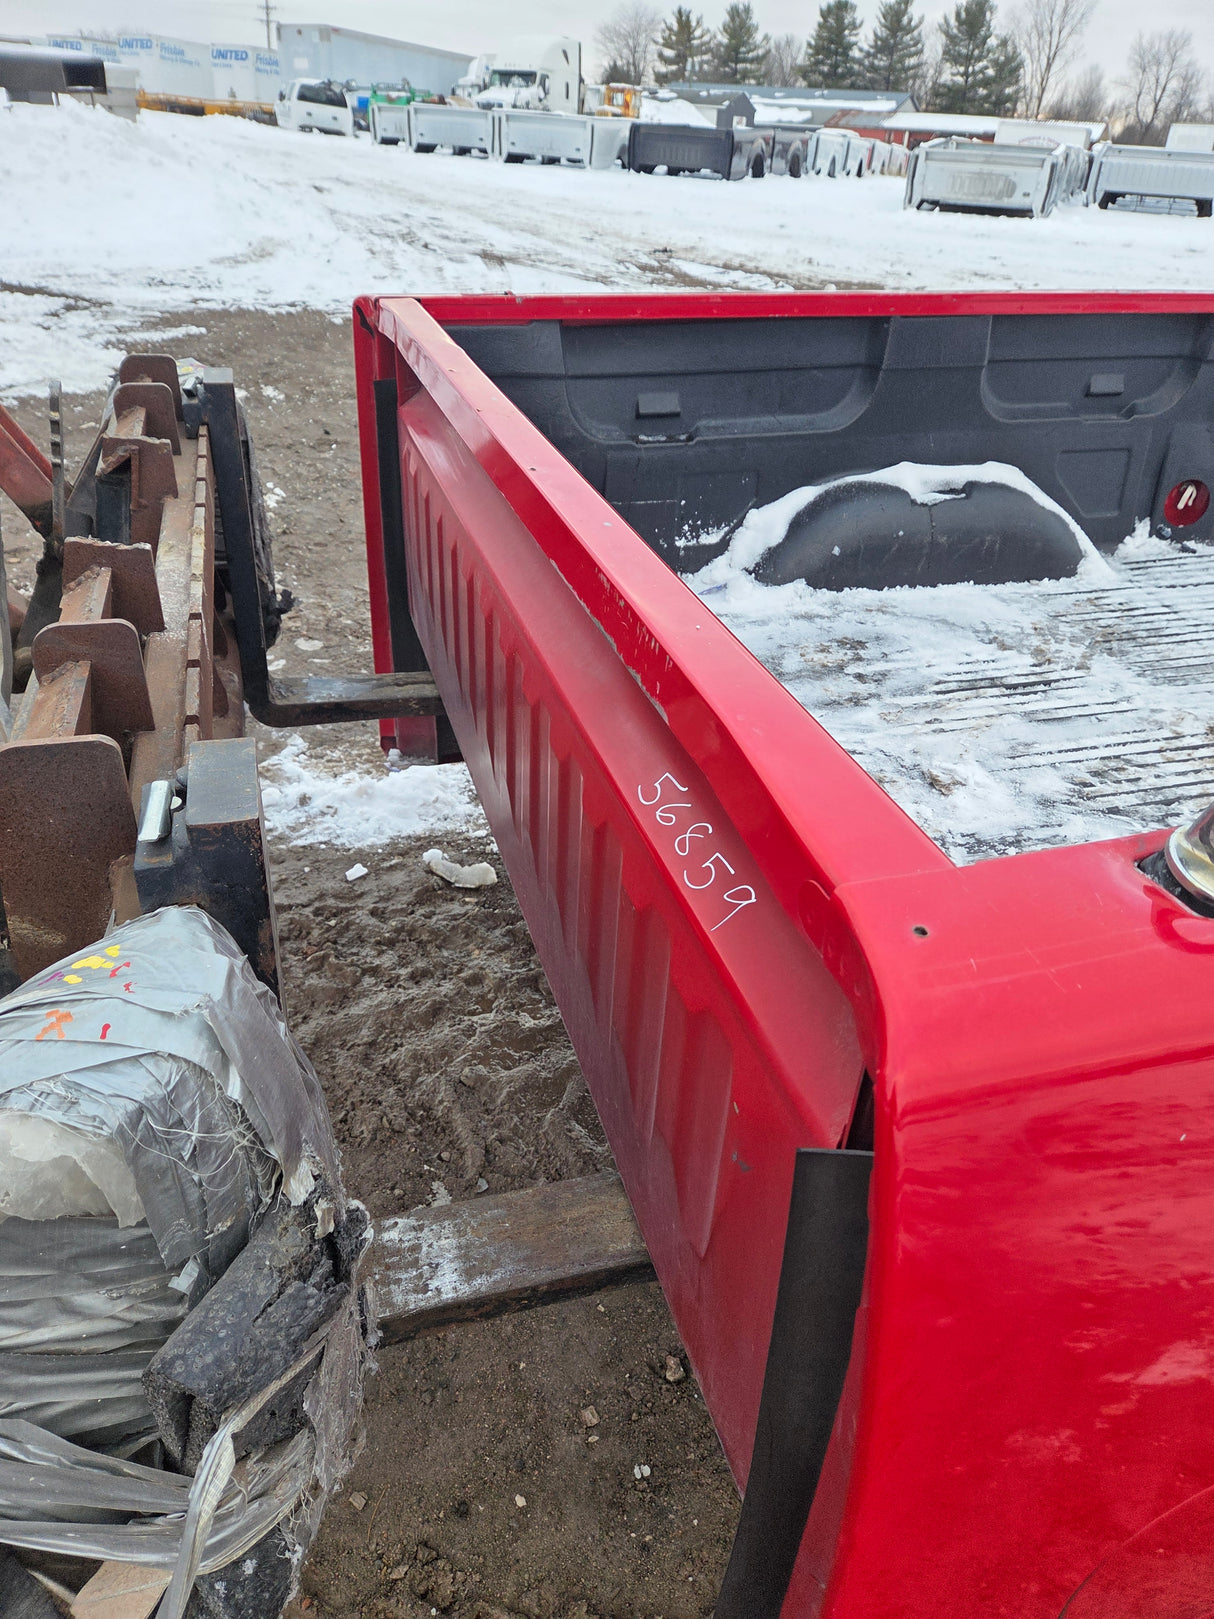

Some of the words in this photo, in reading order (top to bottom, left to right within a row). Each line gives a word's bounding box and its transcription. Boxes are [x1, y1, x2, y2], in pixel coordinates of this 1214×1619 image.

[48, 39, 82, 50] UNITED
[118, 38, 152, 49] UNITED
[211, 48, 249, 61] UNITED
[637, 772, 758, 932] 56859
